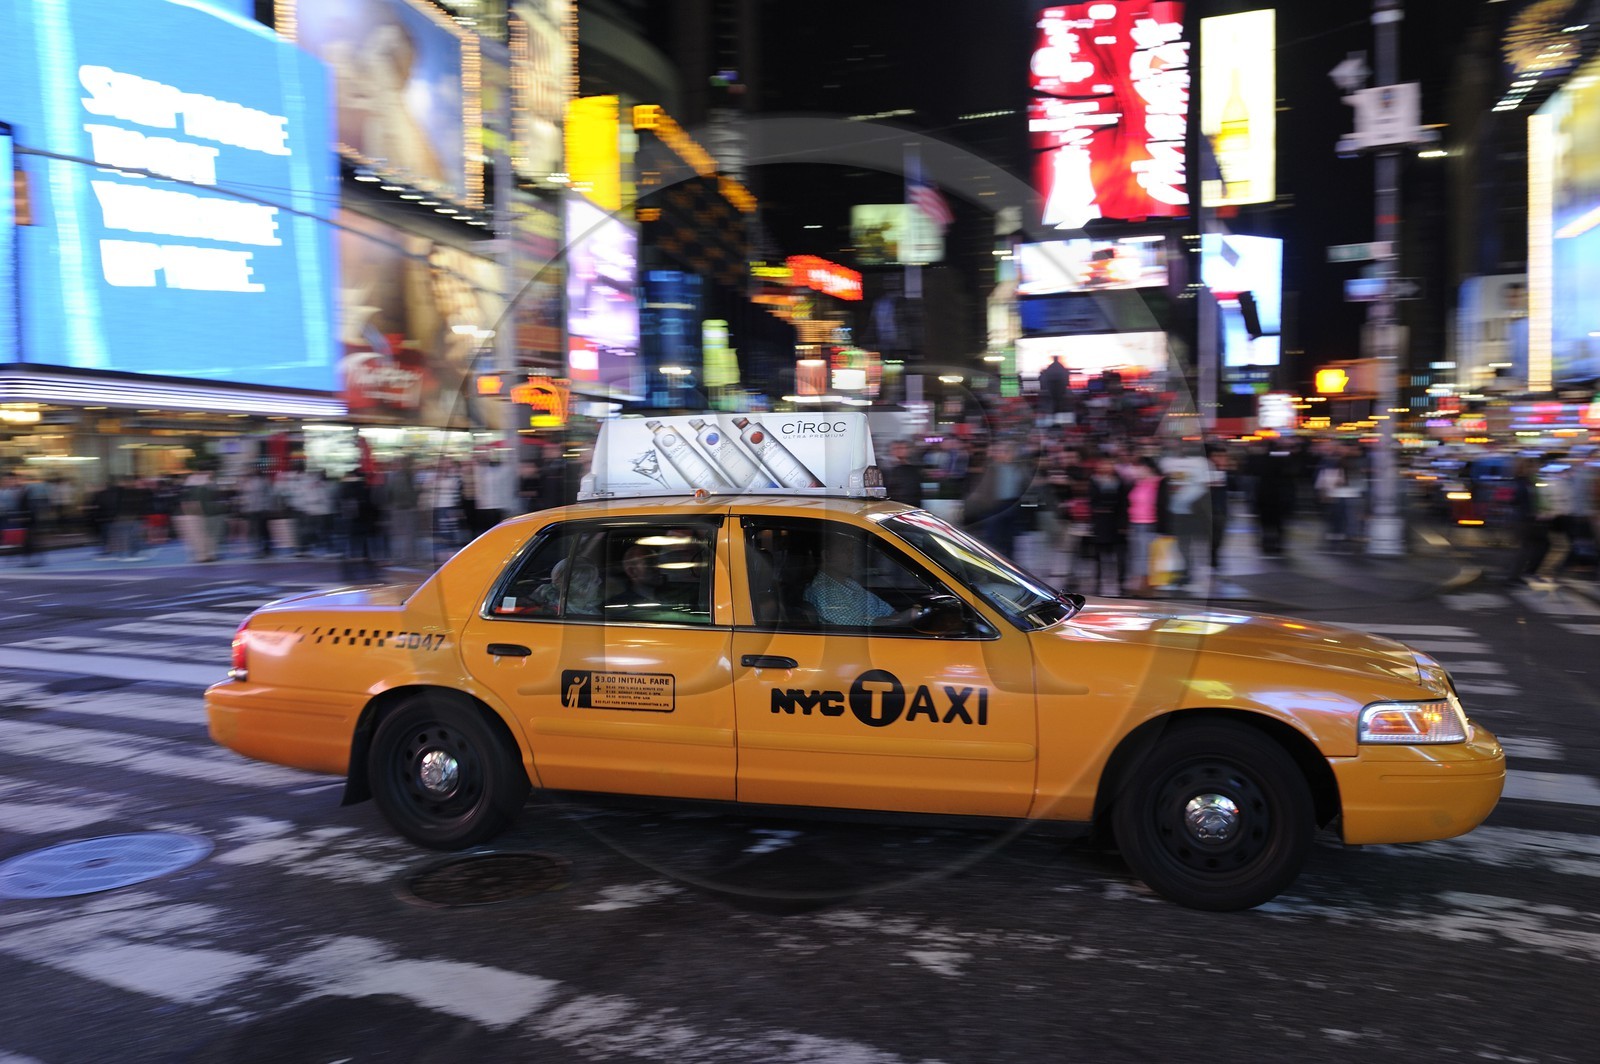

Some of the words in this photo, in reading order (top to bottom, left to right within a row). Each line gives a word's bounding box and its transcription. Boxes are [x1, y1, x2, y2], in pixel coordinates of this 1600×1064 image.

[782, 420, 847, 434] CÎROC
[771, 687, 845, 717] NYC
[856, 675, 988, 726] TAXI
